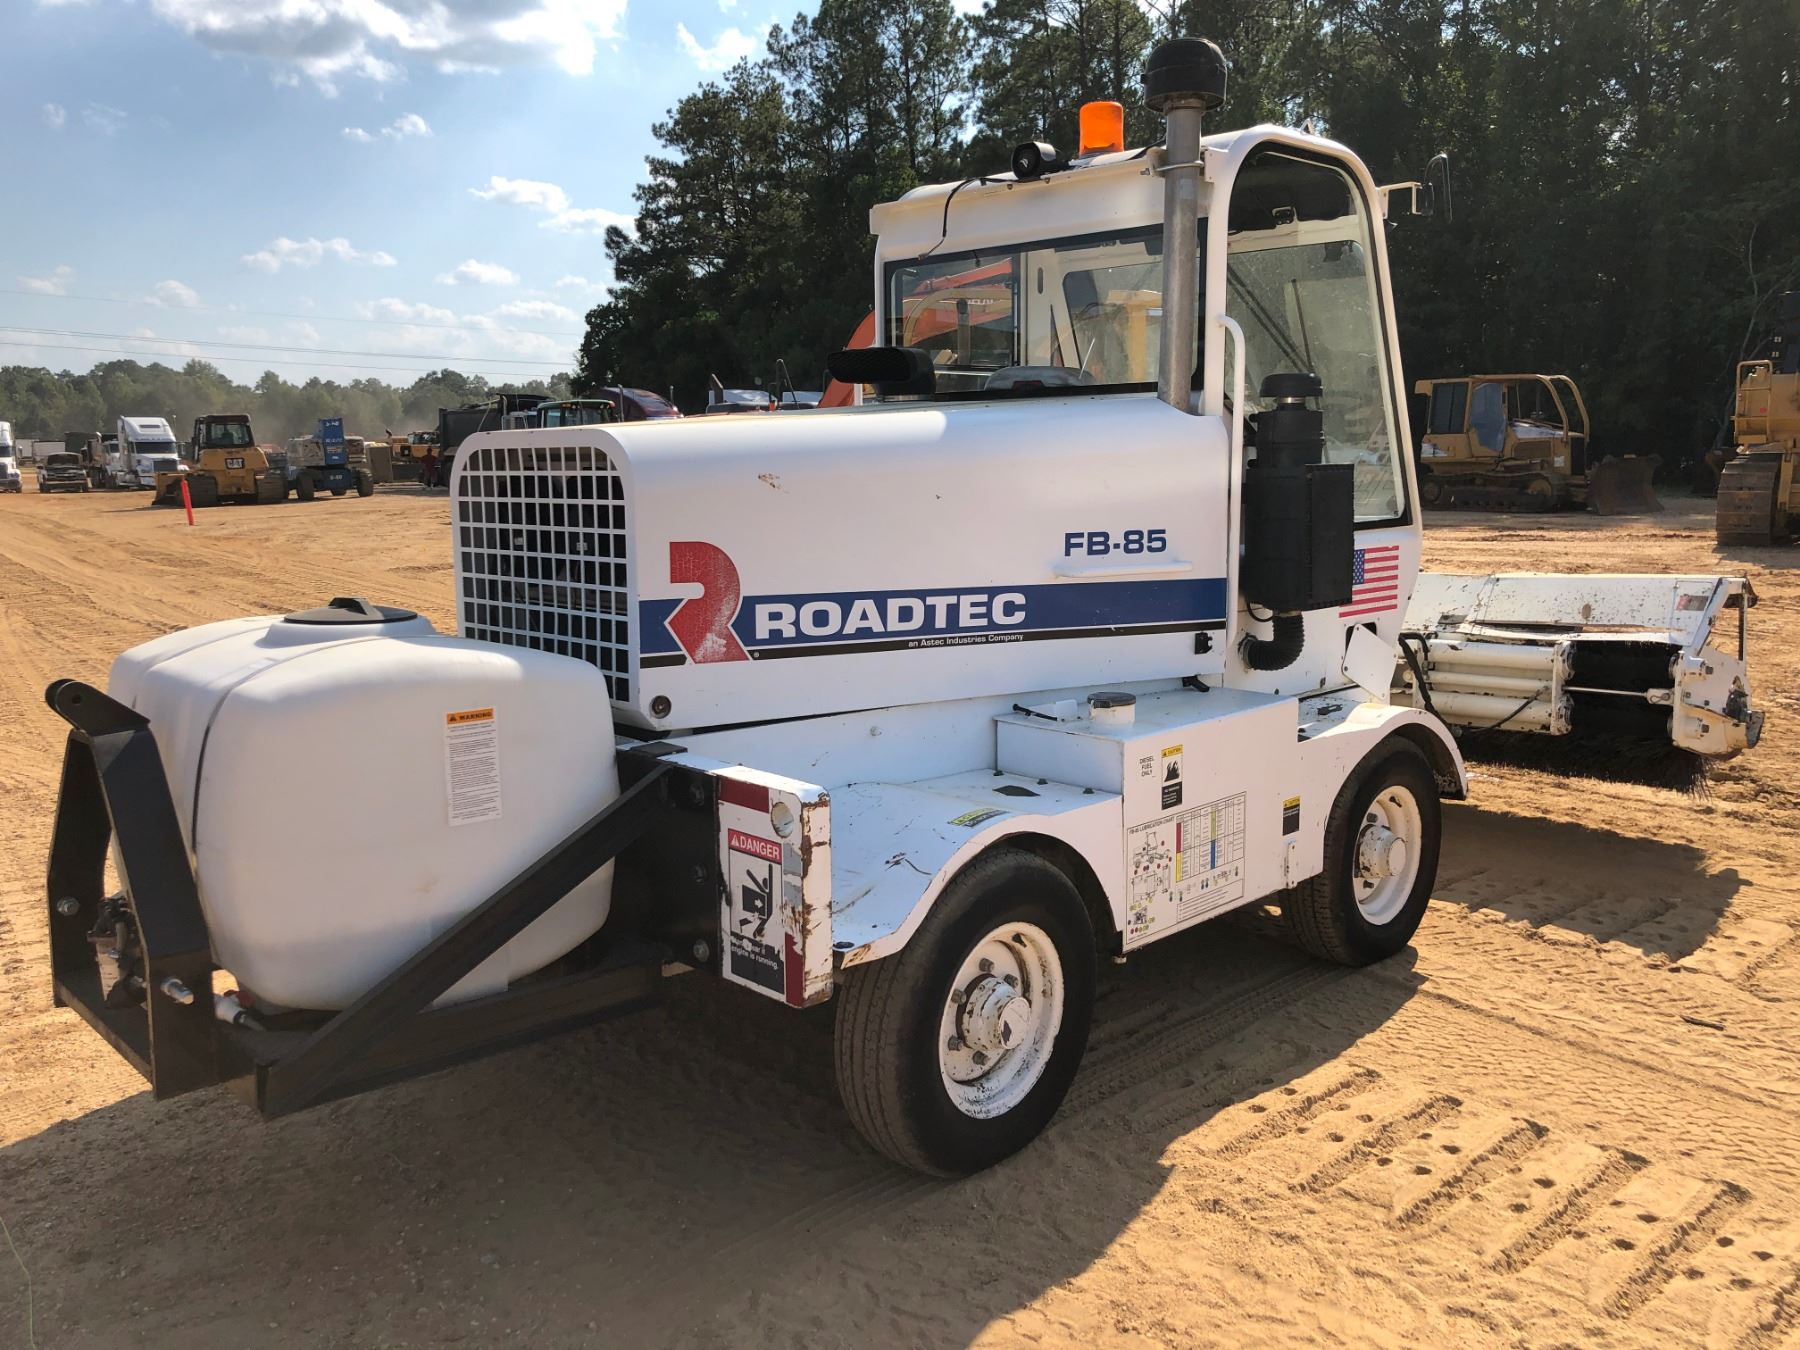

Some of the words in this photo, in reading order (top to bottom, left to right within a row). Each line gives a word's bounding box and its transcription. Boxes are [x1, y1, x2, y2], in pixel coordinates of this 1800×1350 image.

[1064, 529, 1167, 557] FB-85
[755, 592, 1026, 640] ROADTEC
[920, 638, 944, 647] Astec
[946, 635, 986, 645] Industries
[988, 633, 1024, 644] Company
[459, 711, 492, 721] WARNING
[1139, 755, 1154, 764] DIESEL
[740, 836, 780, 860] DANGER
